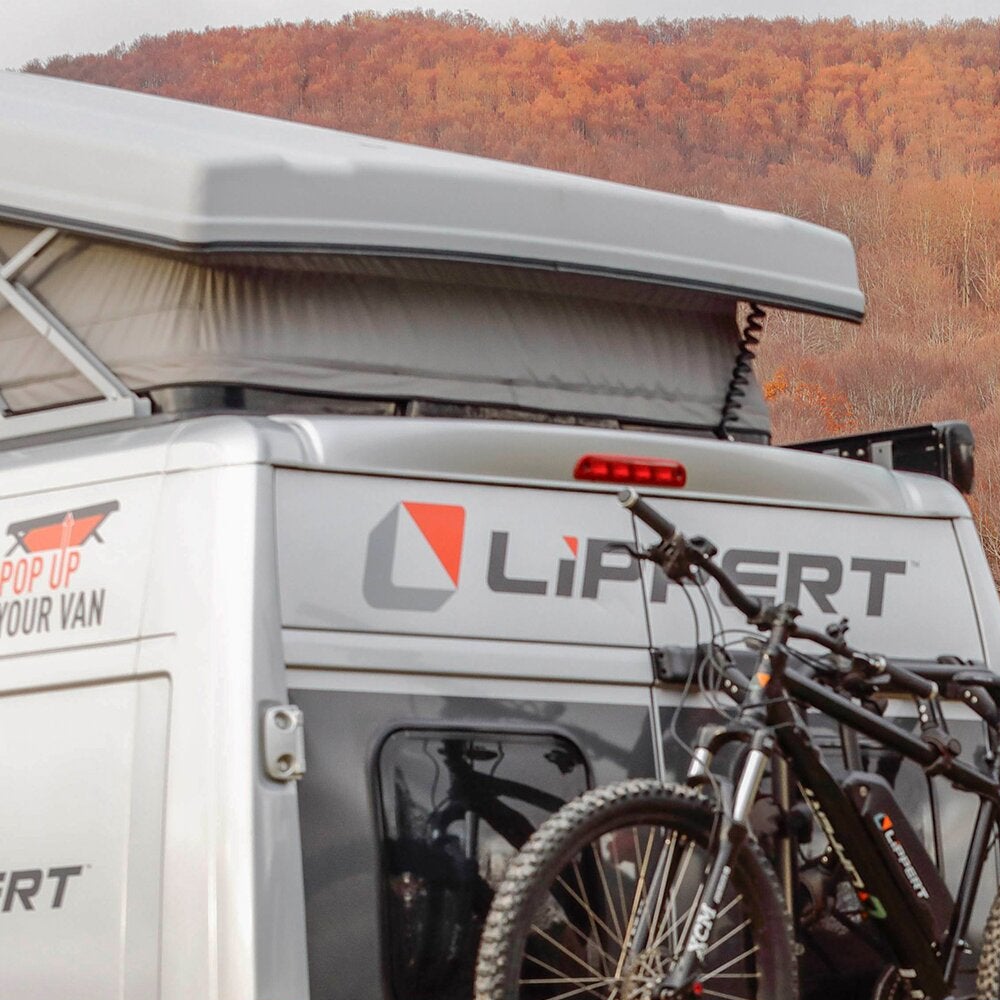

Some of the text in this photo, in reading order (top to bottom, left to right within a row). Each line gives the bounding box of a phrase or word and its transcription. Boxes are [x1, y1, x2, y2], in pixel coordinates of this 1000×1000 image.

[0, 551, 80, 597] POP UP
[0, 588, 106, 638] YOUR VAN
